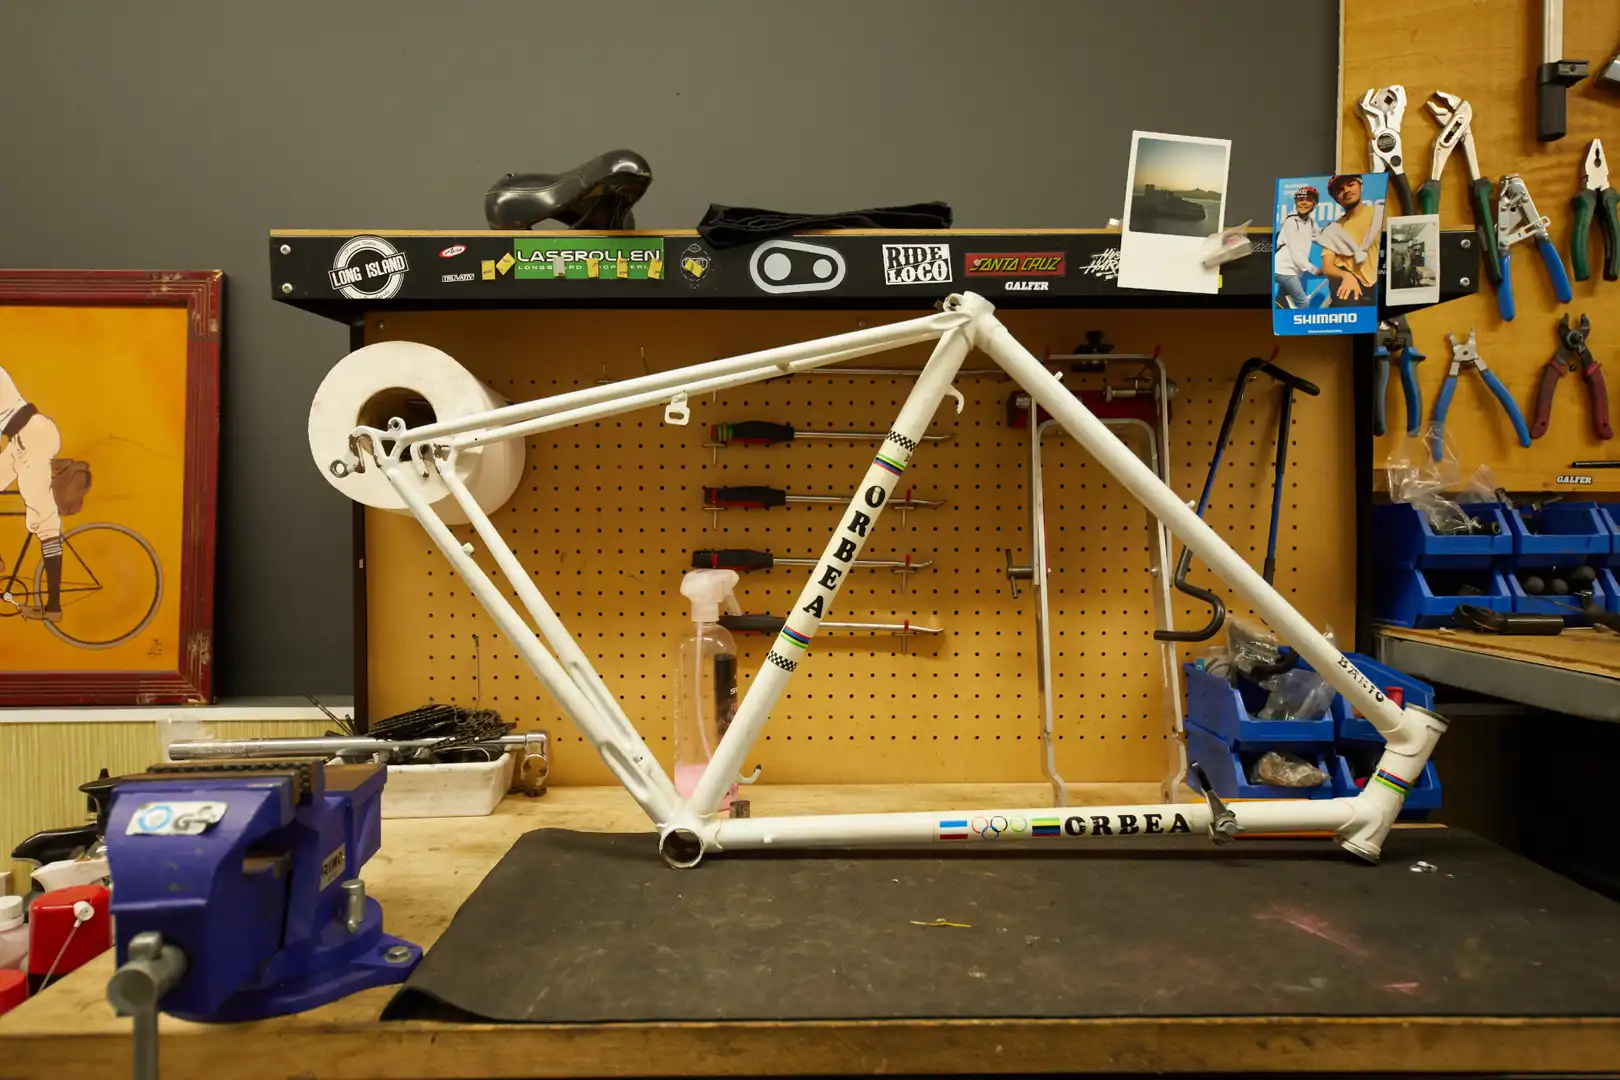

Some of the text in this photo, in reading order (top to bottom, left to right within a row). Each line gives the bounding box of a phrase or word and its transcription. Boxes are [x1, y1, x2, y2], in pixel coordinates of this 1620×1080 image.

[517, 250, 660, 262] LASSROLLEN
[886, 247, 942, 269] RIDE
[969, 256, 1062, 272] SANTA CRUZ
[331, 255, 406, 288] LONG ISLAND
[888, 260, 949, 283] LOCO
[1005, 281, 1049, 291] GALFER
[1293, 312, 1358, 325] SHIMANO
[1556, 475, 1592, 484] GALFER
[802, 485, 886, 619] ORBEA
[1064, 812, 1192, 836] ORBEA
